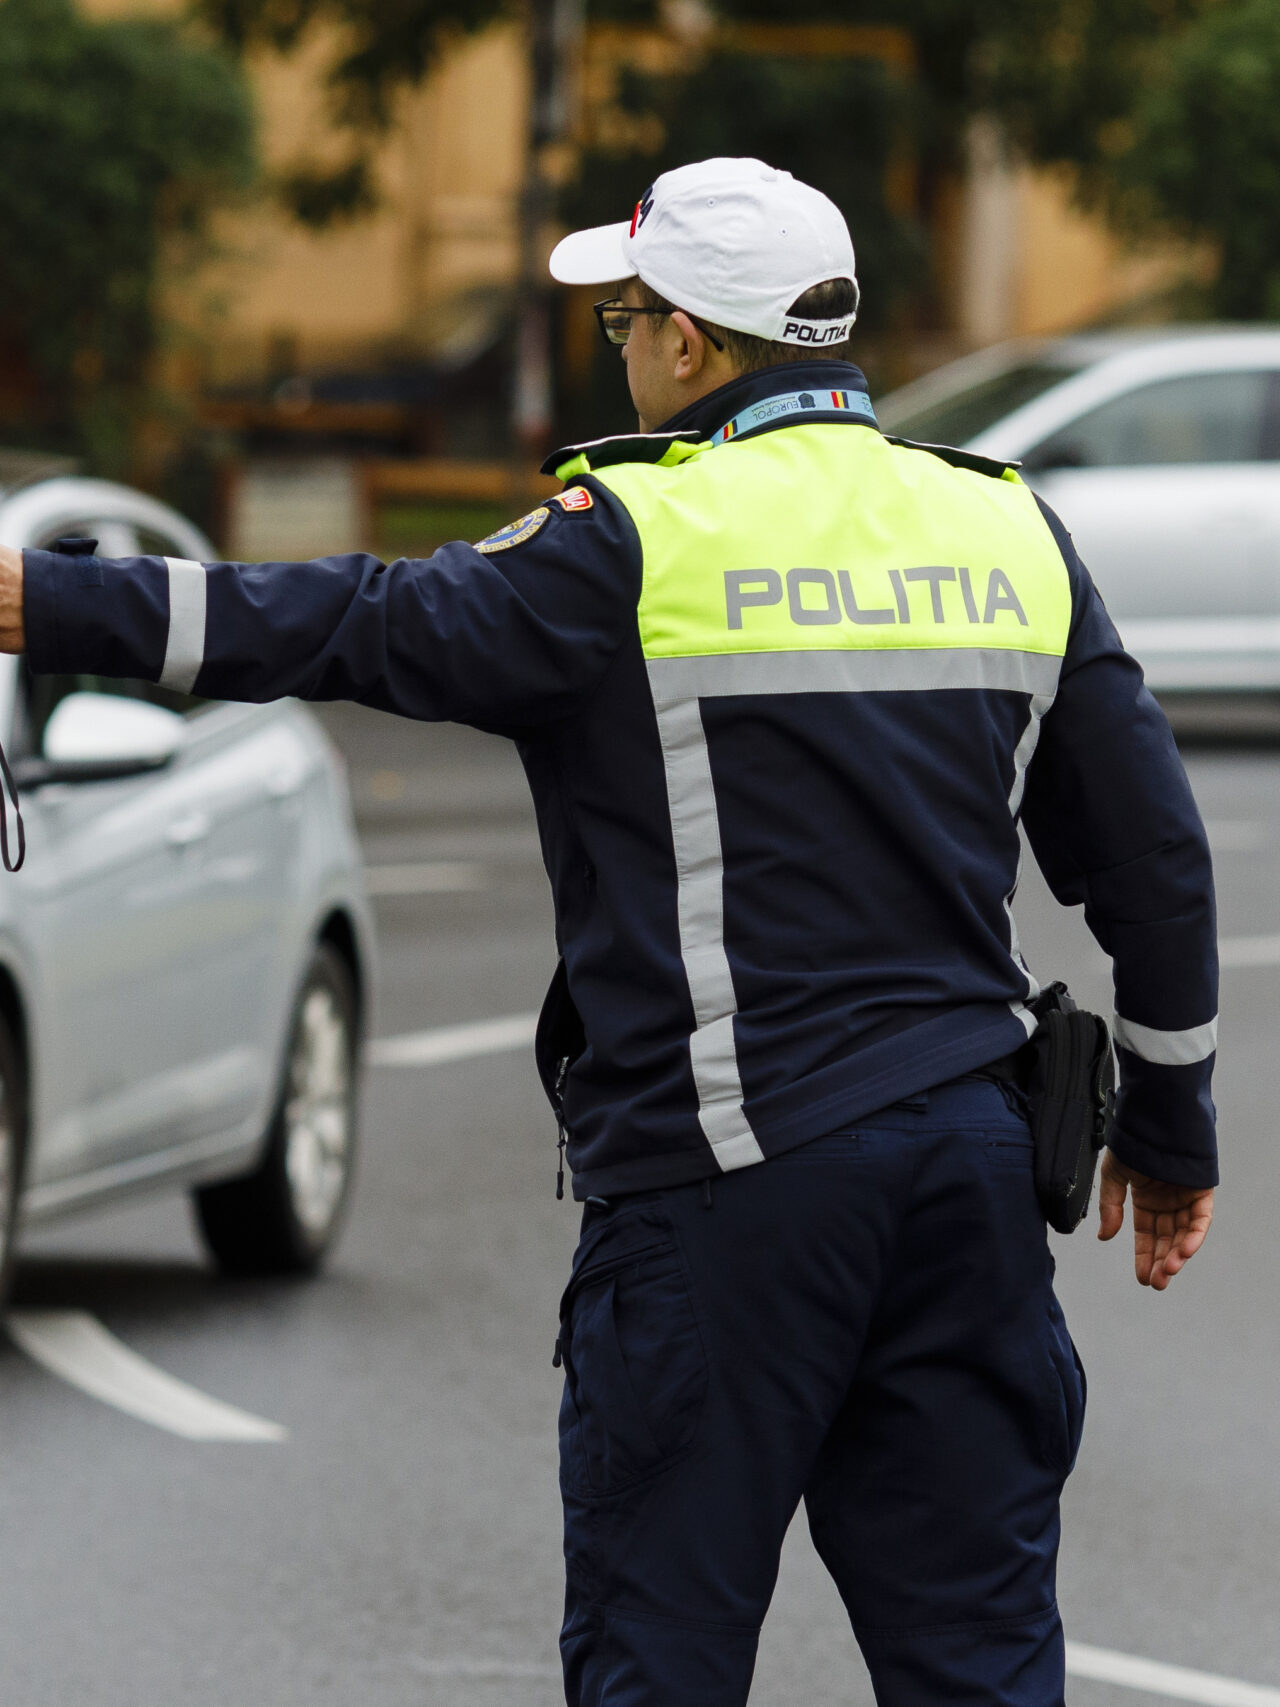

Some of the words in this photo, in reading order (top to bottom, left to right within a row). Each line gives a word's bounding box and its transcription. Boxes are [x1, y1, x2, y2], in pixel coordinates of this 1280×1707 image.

[782, 322, 848, 343] POLITIA
[752, 400, 799, 422] EUROPOL
[723, 566, 1029, 630] POLITIA
